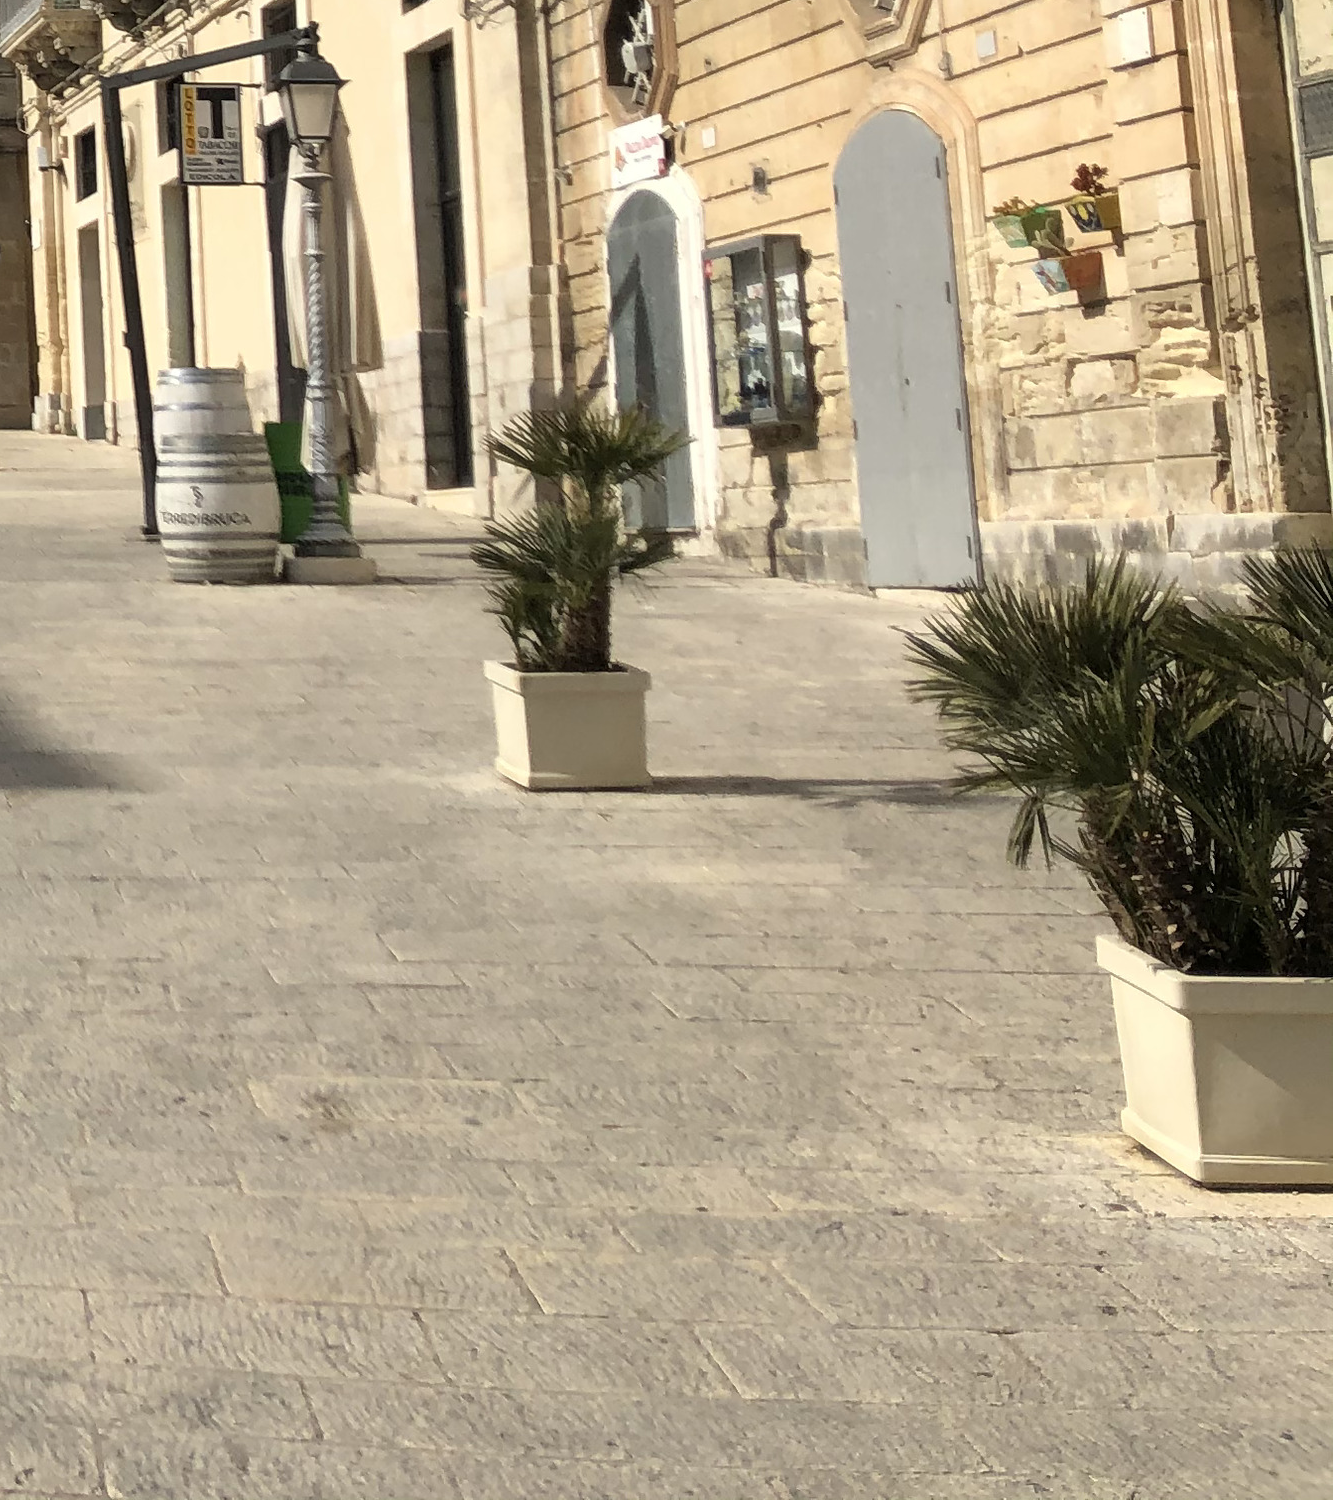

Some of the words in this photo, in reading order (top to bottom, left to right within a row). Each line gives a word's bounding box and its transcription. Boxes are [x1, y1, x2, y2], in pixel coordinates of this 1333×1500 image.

[184, 87, 195, 149] LOTTO
[196, 87, 236, 139] T
[189, 173, 237, 181] EDICOLA
